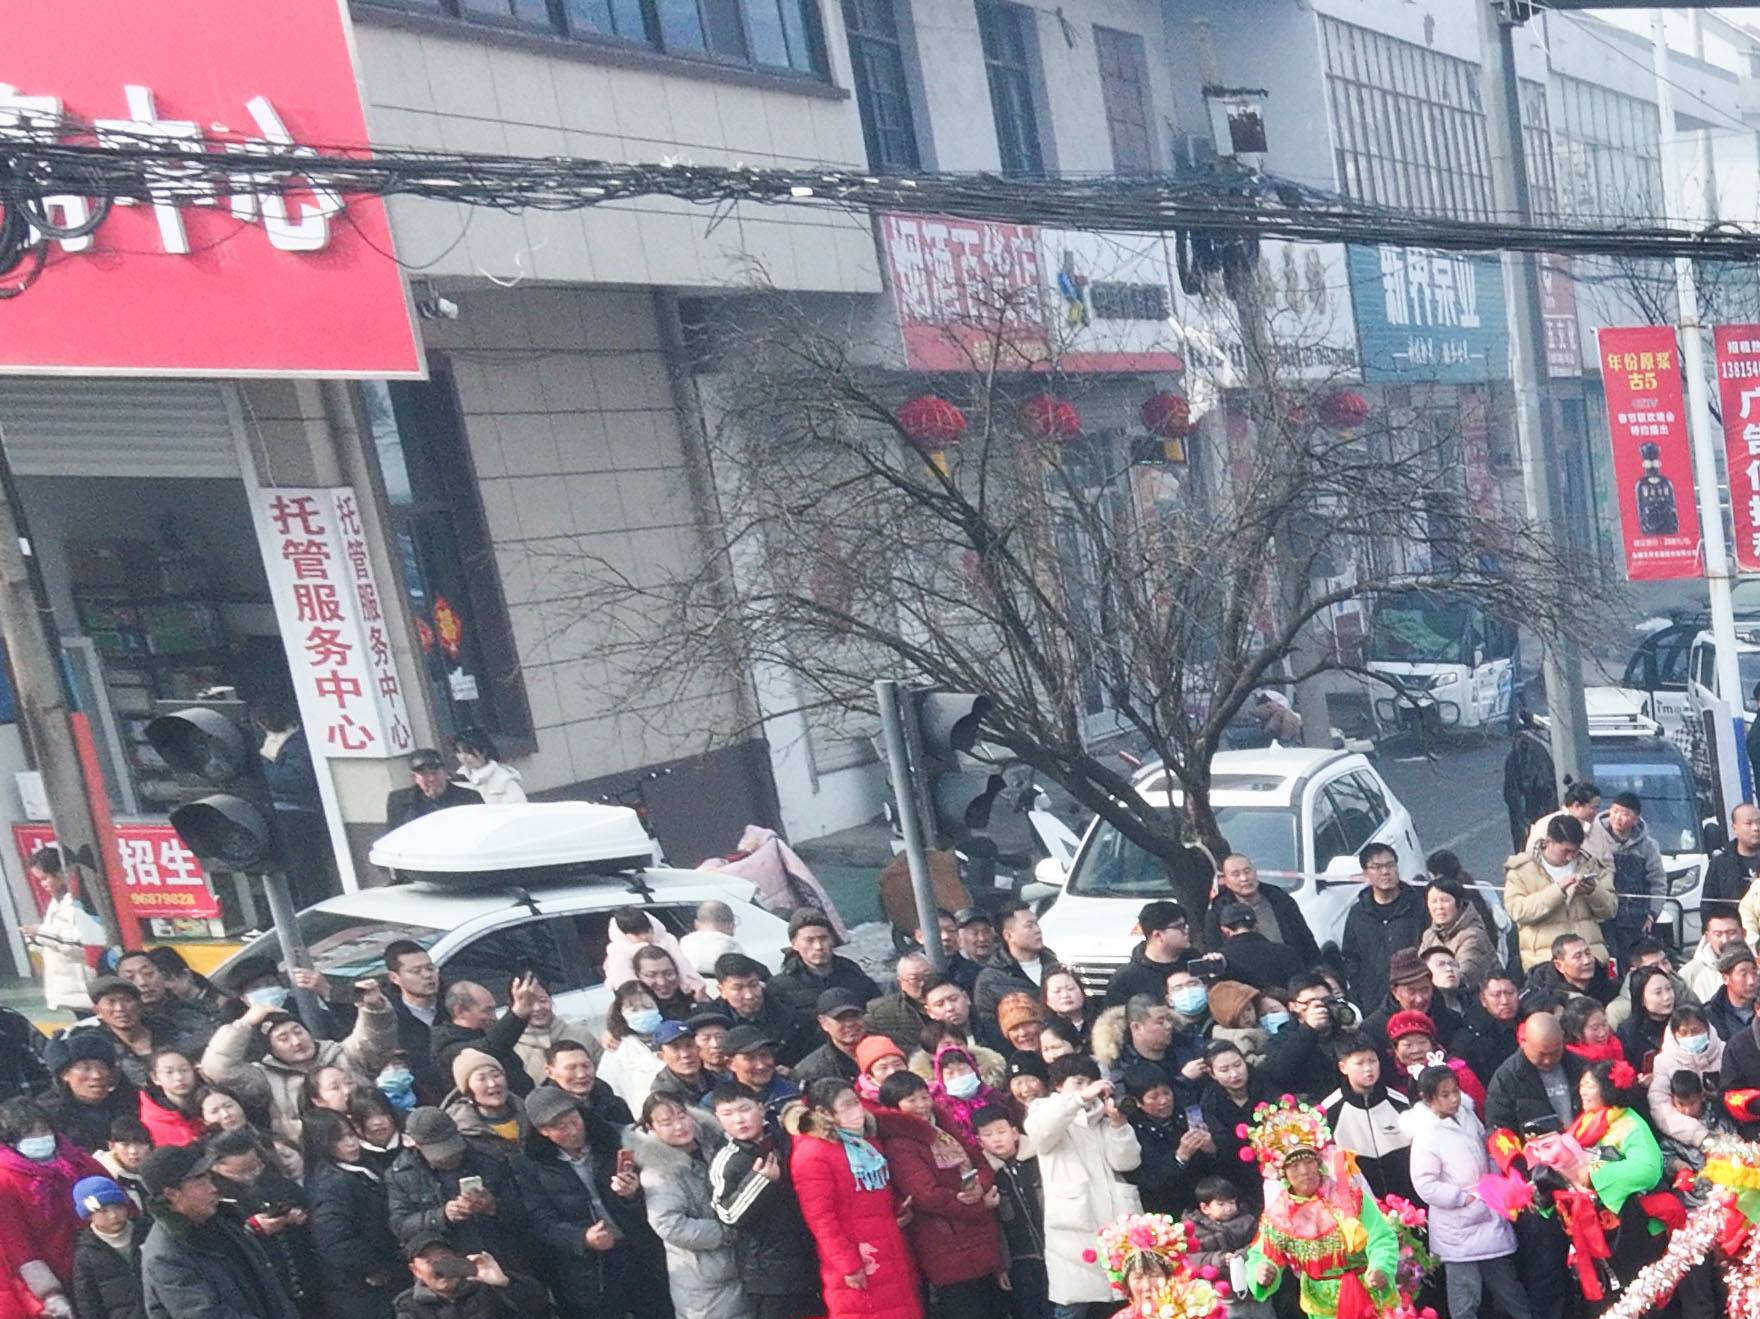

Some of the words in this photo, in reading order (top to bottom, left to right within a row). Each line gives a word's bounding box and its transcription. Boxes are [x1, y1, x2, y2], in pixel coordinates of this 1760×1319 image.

[0, 82, 345, 253] 中心
[1607, 351, 1671, 372] 年份原浆
[1628, 372, 1658, 391] 古5
[269, 495, 375, 750] 托管服务中心
[336, 496, 412, 749] 托管服务中心
[117, 838, 204, 886] 招生
